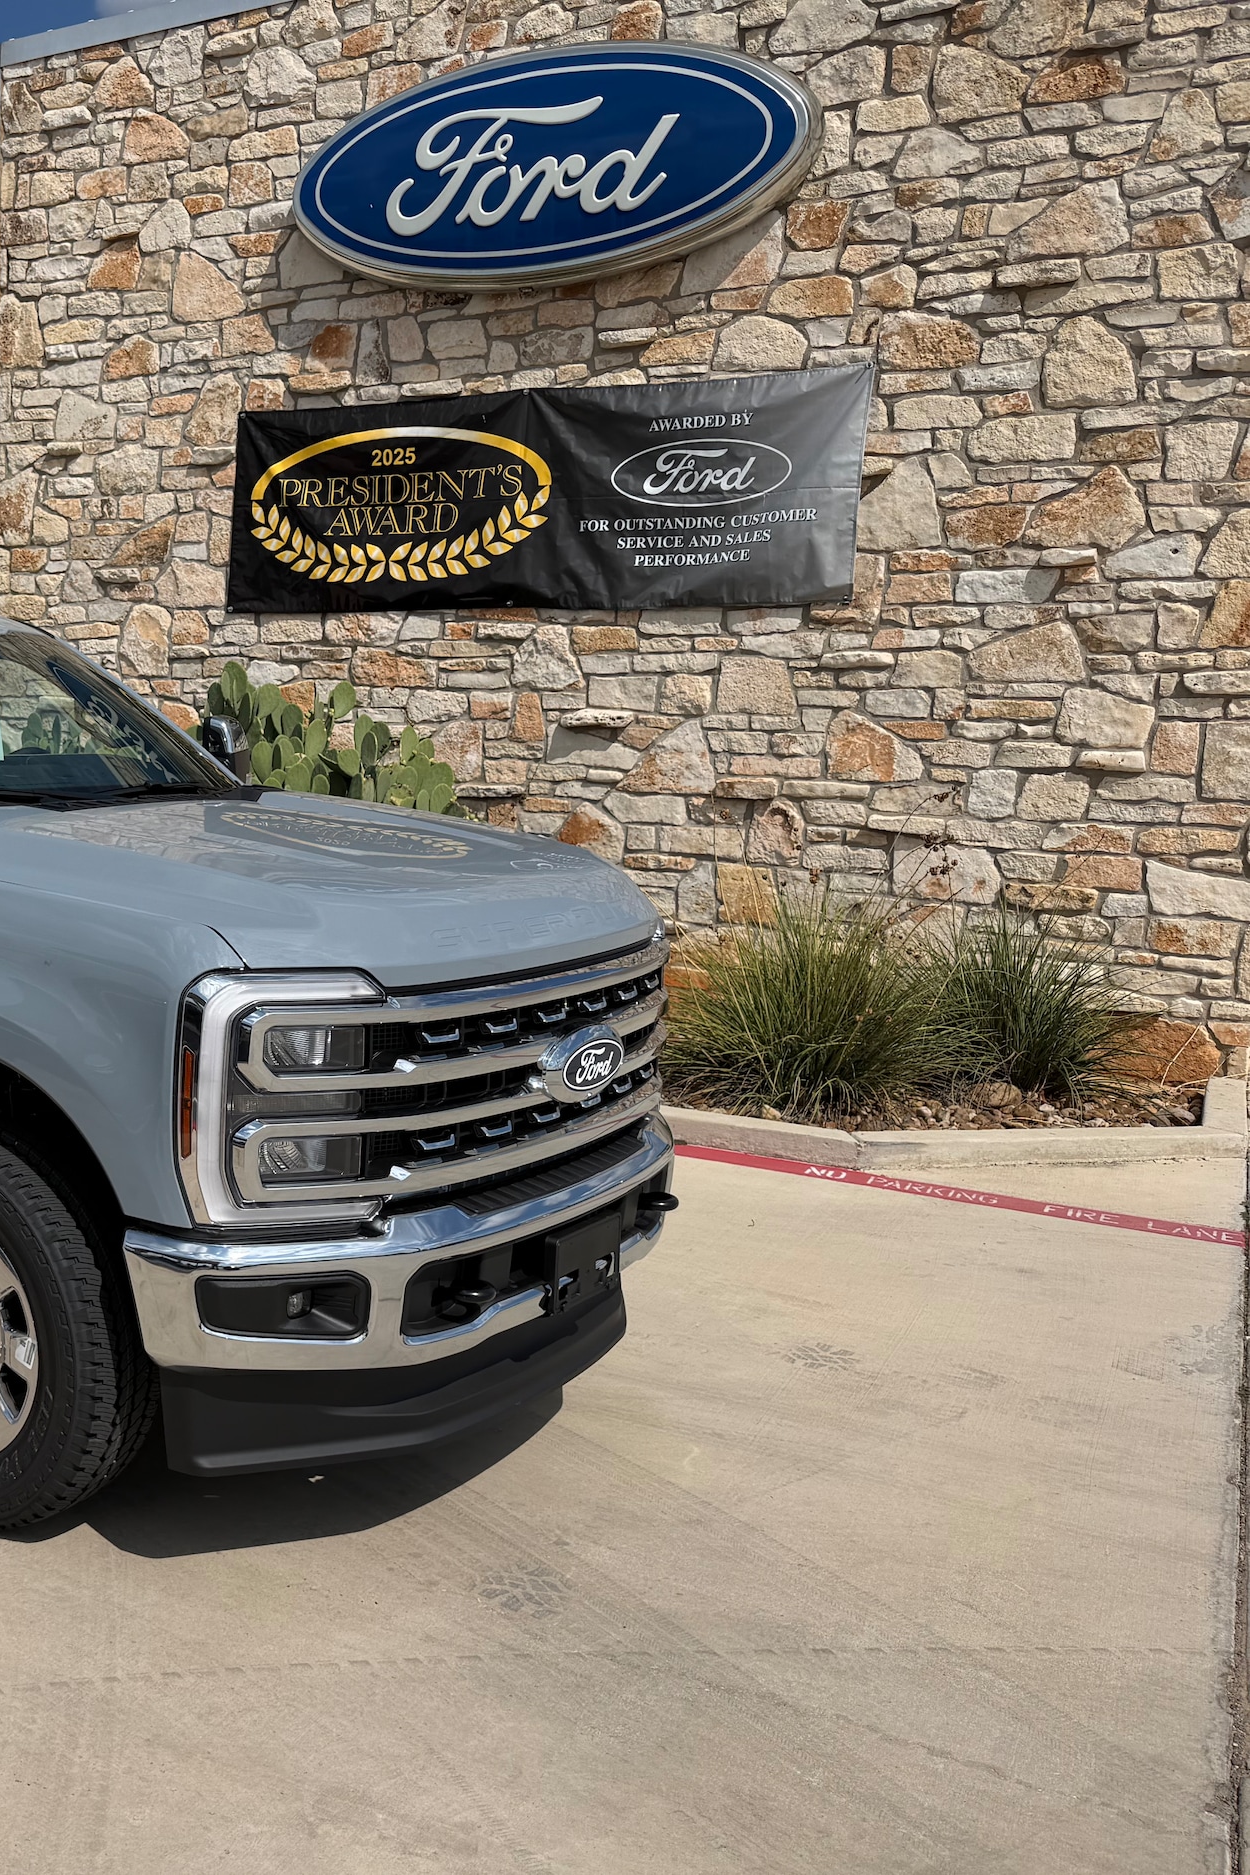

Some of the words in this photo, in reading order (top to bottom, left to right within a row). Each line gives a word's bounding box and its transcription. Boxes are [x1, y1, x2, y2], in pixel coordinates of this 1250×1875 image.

[386, 96, 680, 236] Ford
[648, 414, 727, 432] AWARDED
[731, 411, 754, 426] BY
[371, 447, 417, 467] 2025
[643, 448, 756, 495] Ford
[278, 464, 523, 508] PRESIDENT'S
[323, 503, 459, 536] AWARD
[579, 519, 610, 532] FOR
[614, 516, 726, 531] OUTSTANDING
[731, 508, 817, 528] CUSTOMER
[616, 535, 684, 550] SERVICE
[688, 534, 722, 548] AND
[725, 529, 771, 546] SALES
[634, 549, 751, 567] PERFORMANCE
[576, 1047, 614, 1084] Ford
[804, 1166, 847, 1180] NO
[866, 1175, 999, 1204] PARKING
[1043, 1204, 1120, 1224] FIRE
[1147, 1221, 1244, 1244] LANE
